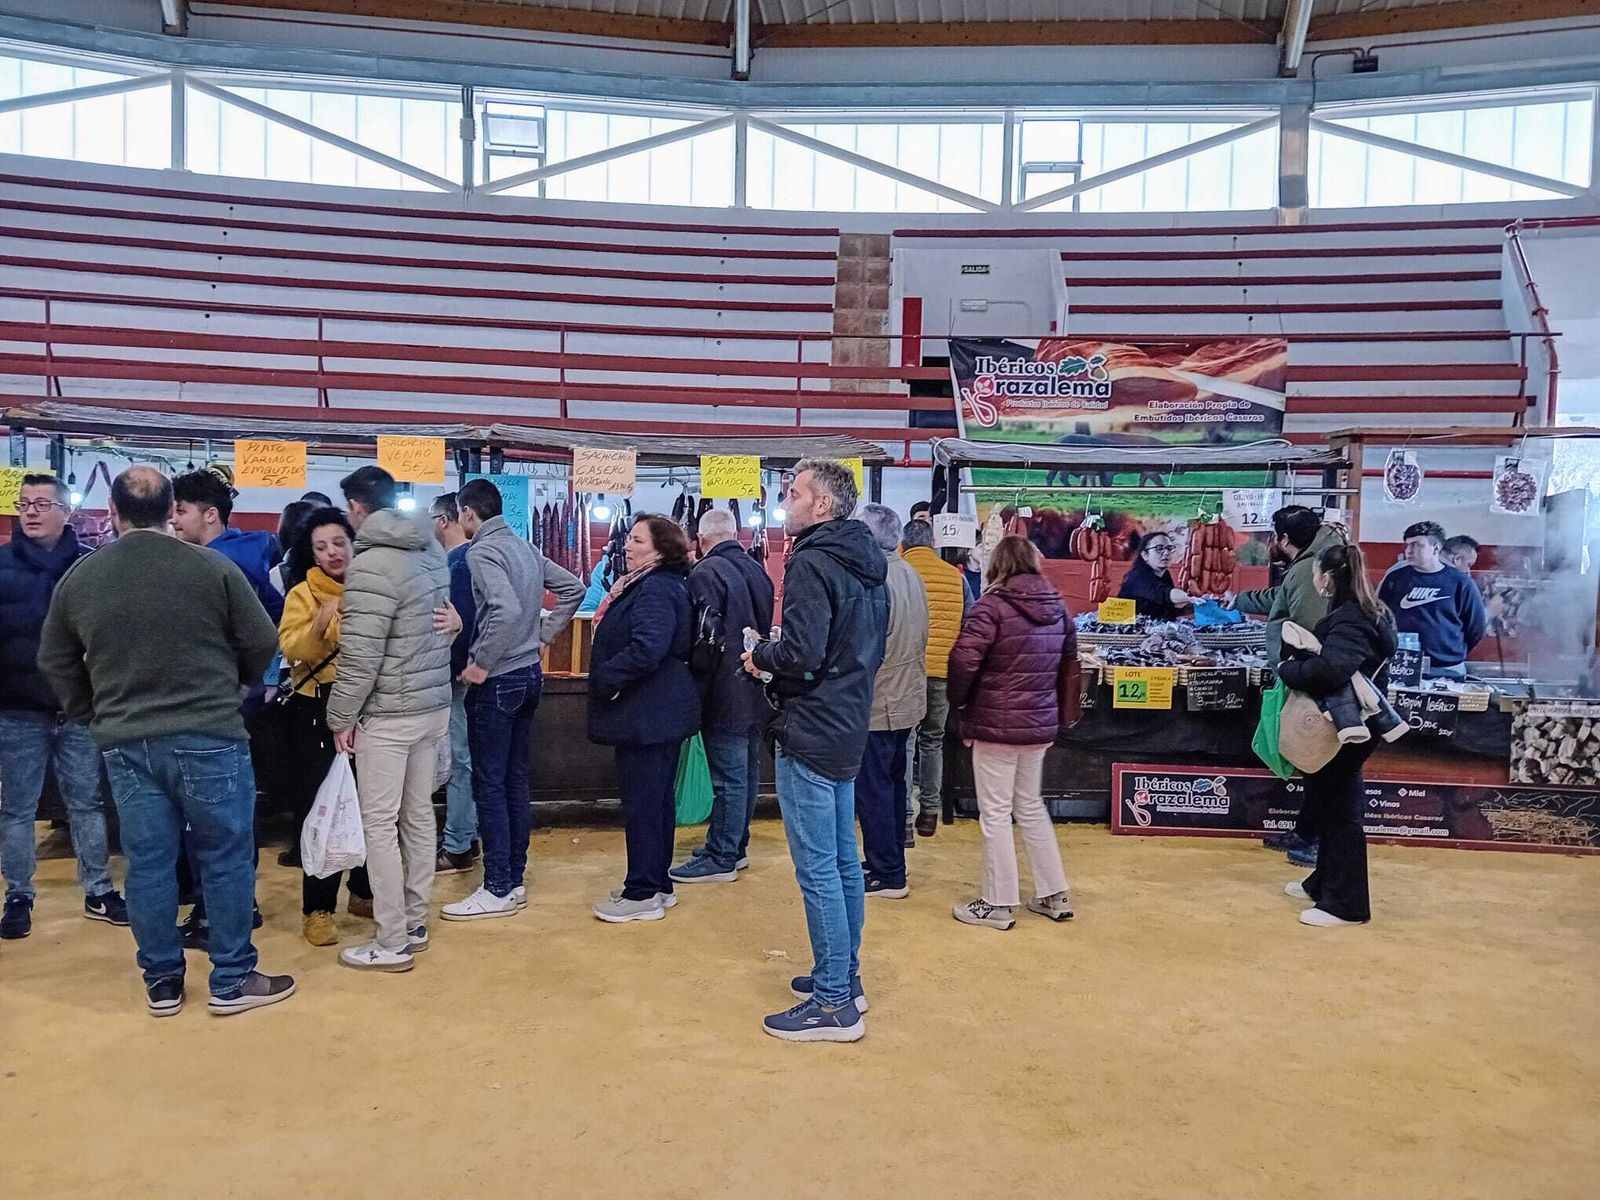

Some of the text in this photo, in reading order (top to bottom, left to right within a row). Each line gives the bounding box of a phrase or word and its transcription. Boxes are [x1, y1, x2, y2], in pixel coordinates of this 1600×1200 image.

[975, 356, 1056, 375] Ibéricos
[1148, 400, 1251, 410] Elaboración Propia de
[1134, 412, 1265, 423] Embutidos Ibéricos Caseros
[247, 442, 286, 453] PLATO
[708, 456, 749, 466] PLATO
[576, 465, 627, 476] CASERO
[1408, 587, 1441, 599] NIKE
[1134, 777, 1192, 792] Ibéricos
[1379, 800, 1400, 808] Vinos
[1362, 825, 1449, 836] razalema@gmail.com
